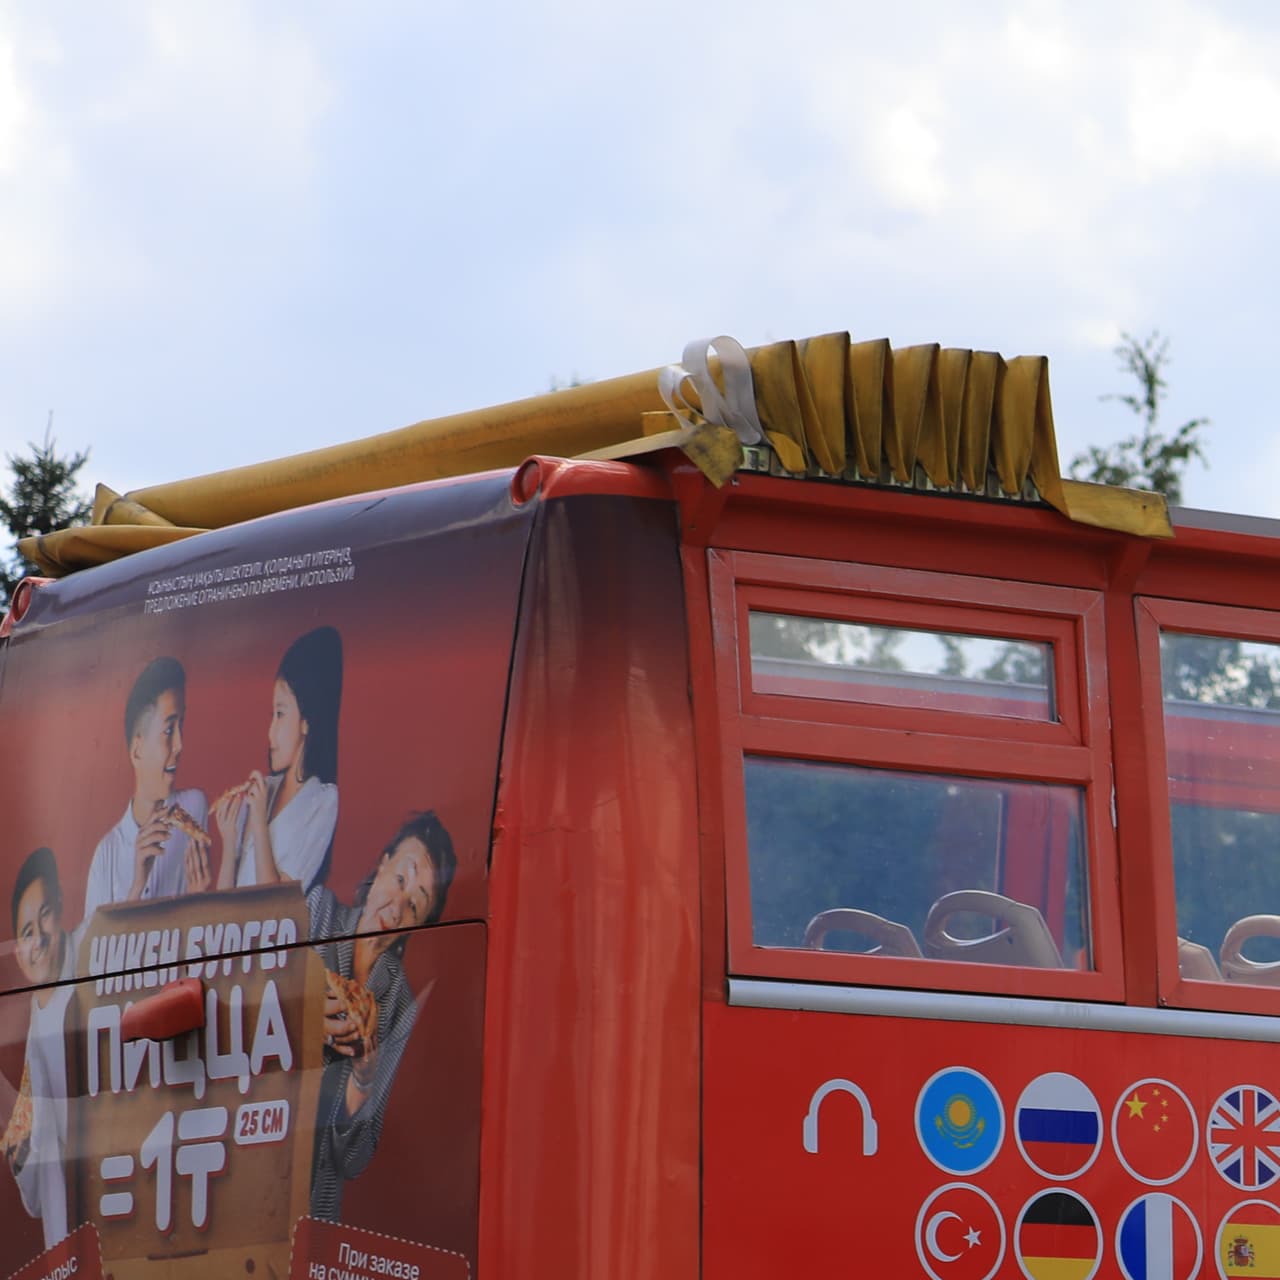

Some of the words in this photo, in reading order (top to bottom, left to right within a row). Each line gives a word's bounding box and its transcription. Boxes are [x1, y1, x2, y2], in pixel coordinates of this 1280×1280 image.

[90, 928, 180, 996] ЧИКЕН
[186, 918, 298, 979] БУРГЕР
[240, 1107, 259, 1138] 25
[262, 1105, 284, 1136] СМ
[338, 1242, 368, 1269] При
[309, 1262, 326, 1280] на
